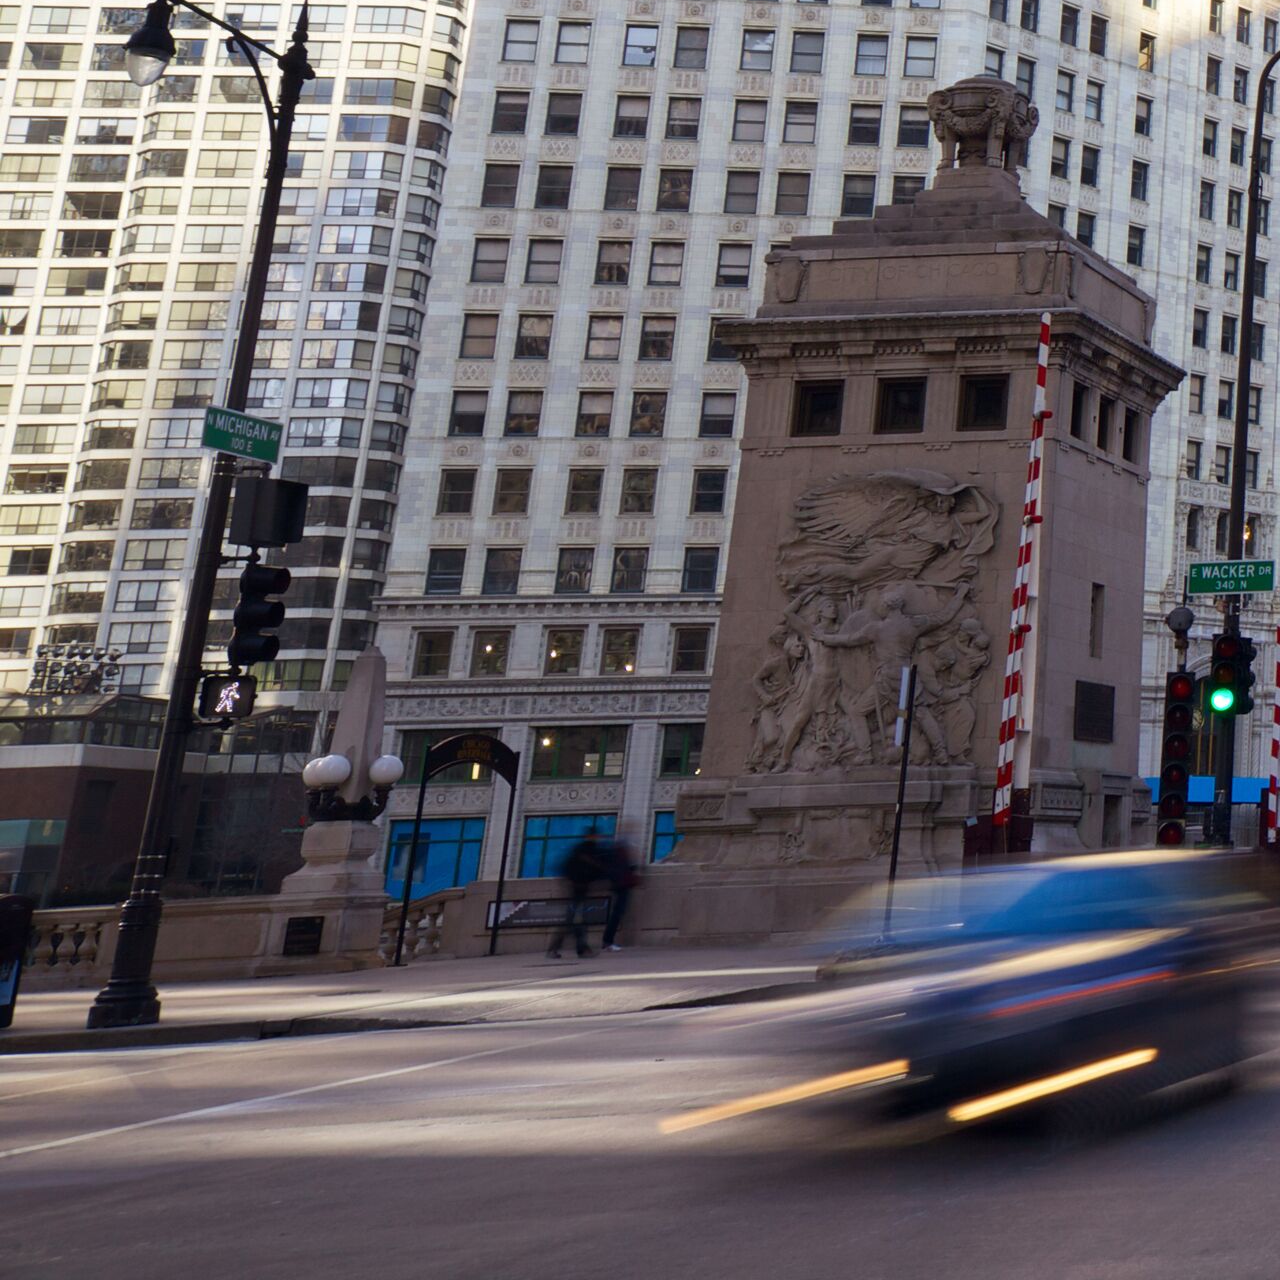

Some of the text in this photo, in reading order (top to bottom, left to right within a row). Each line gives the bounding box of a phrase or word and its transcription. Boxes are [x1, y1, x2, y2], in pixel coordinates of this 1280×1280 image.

[208, 413, 214, 425] N
[215, 413, 269, 441] MICHIGAN
[231, 438, 253, 452] 100 E
[1191, 565, 1272, 579] E WACKER DR
[1215, 580, 1247, 590] 340 N
